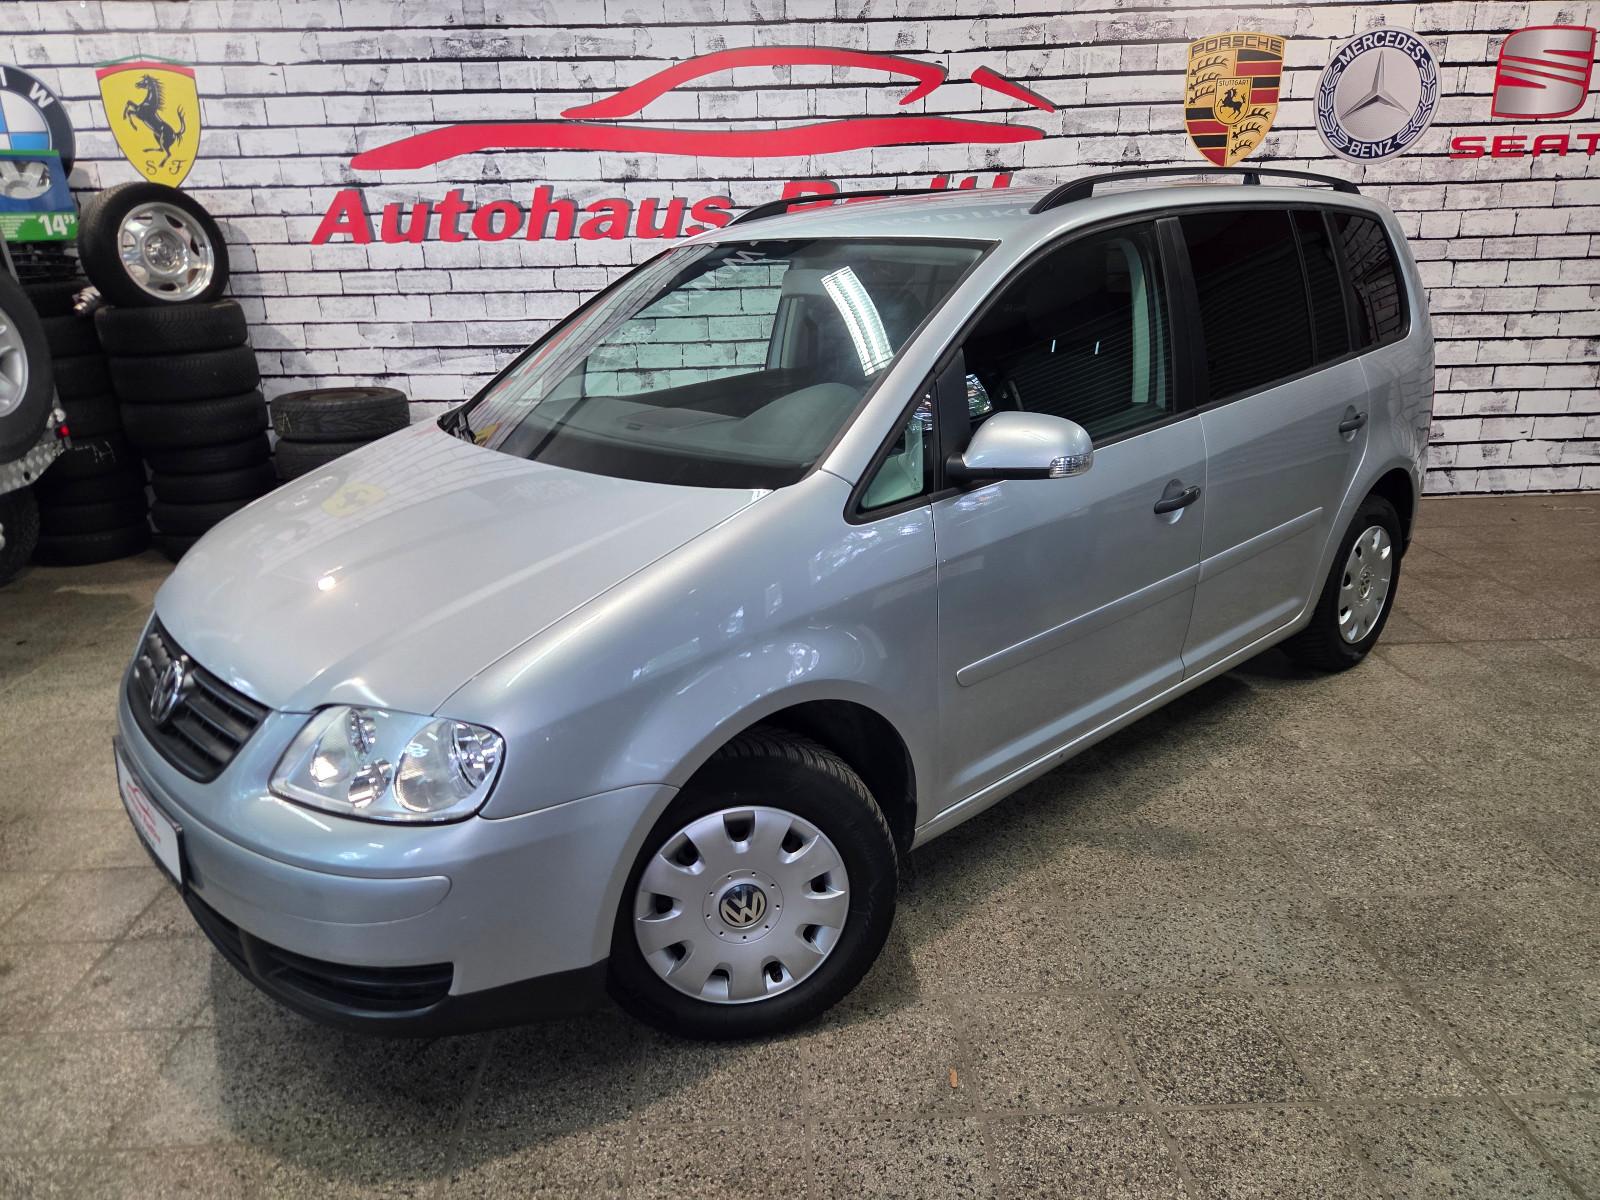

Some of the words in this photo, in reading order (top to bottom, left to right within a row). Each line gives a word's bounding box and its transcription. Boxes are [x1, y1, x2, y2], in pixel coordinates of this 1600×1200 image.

[1191, 35, 1282, 58] PORSCHE
[1338, 31, 1424, 66] MERCEDES
[1218, 79, 1249, 87] STUTTGART
[1348, 138, 1395, 157] BENZ
[1449, 133, 1600, 159] SEAT
[145, 159, 157, 176] S
[169, 159, 187, 176] F
[311, 184, 735, 246] Autohaus
